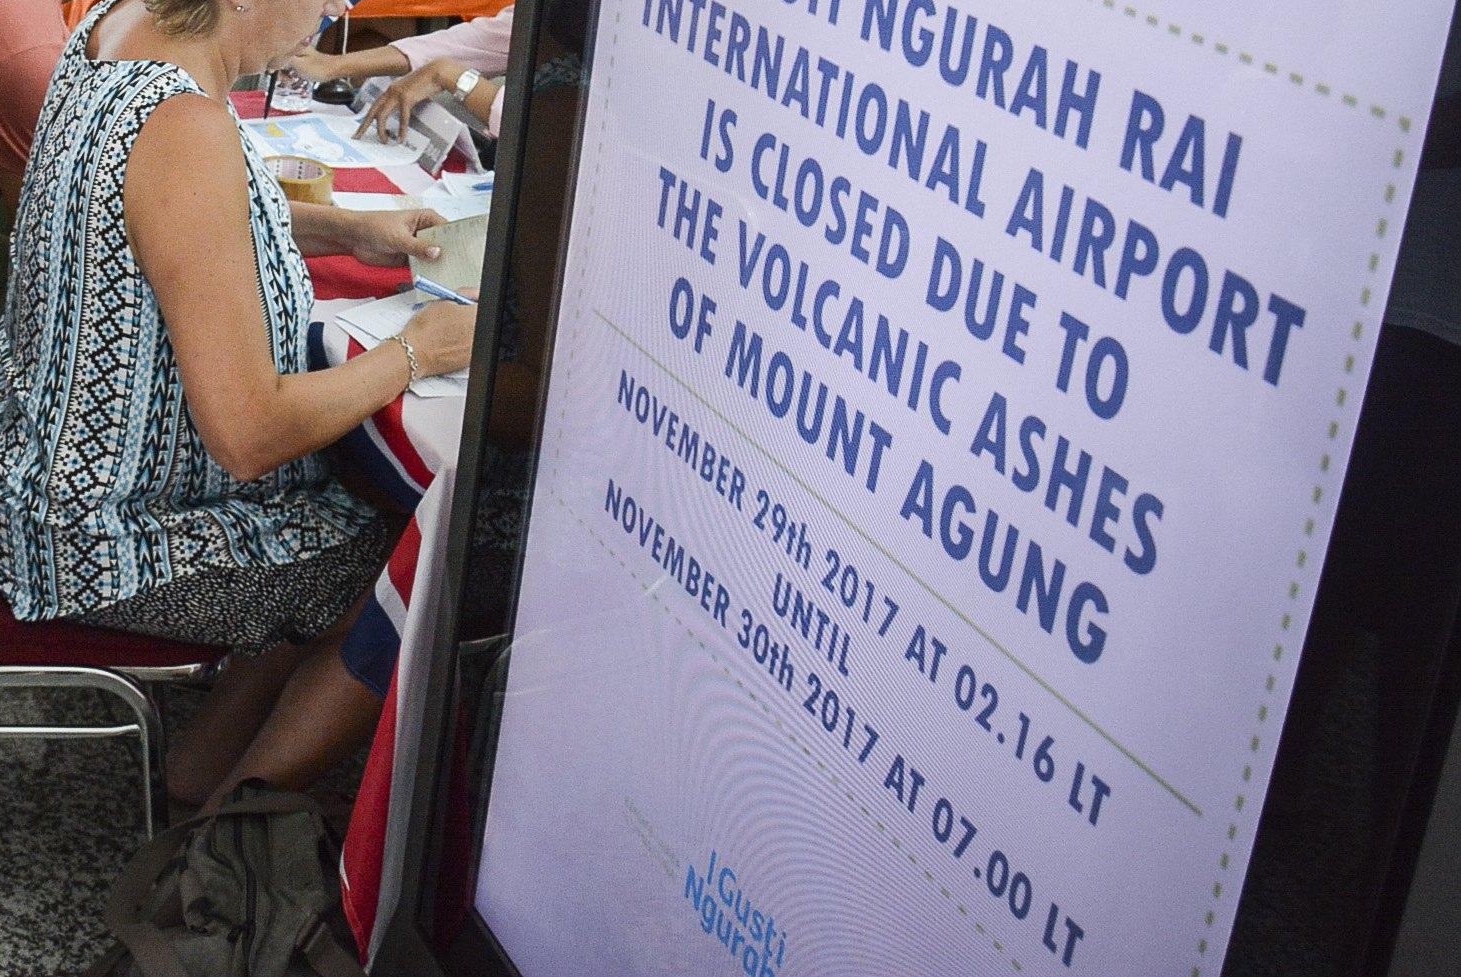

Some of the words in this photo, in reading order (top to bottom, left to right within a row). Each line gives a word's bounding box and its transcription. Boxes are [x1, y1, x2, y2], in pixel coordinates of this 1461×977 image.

[699, 98, 738, 174] IS
[750, 131, 911, 280] CLOSED
[925, 235, 1038, 366] DUE
[1055, 309, 1130, 421] TO
[1004, 166, 1307, 388] AIRPORT
[1118, 88, 1243, 220] RAI
[657, 166, 724, 266] THE
[738, 219, 962, 436] VOLCANIC
[969, 390, 1165, 576] ASHES
[668, 276, 718, 355] OF
[724, 319, 893, 494] MOUNT
[899, 458, 1110, 665] AGUNG
[604, 479, 731, 628] NOVEMBER
[736, 607, 795, 692] 30th
[802, 671, 880, 764] 2017
[883, 754, 926, 814] AT
[931, 796, 1033, 921] 07.00
[1042, 903, 1085, 968] LT
[618, 369, 746, 512] NOVEMBER
[752, 488, 812, 571] 29th
[820, 547, 900, 638] 2017
[904, 623, 948, 683] AT
[954, 663, 1056, 784] 02.16
[1068, 760, 1111, 827] LT
[772, 571, 851, 677] UNTIL
[707, 848, 717, 886] I
[717, 867, 787, 968] Gusti
